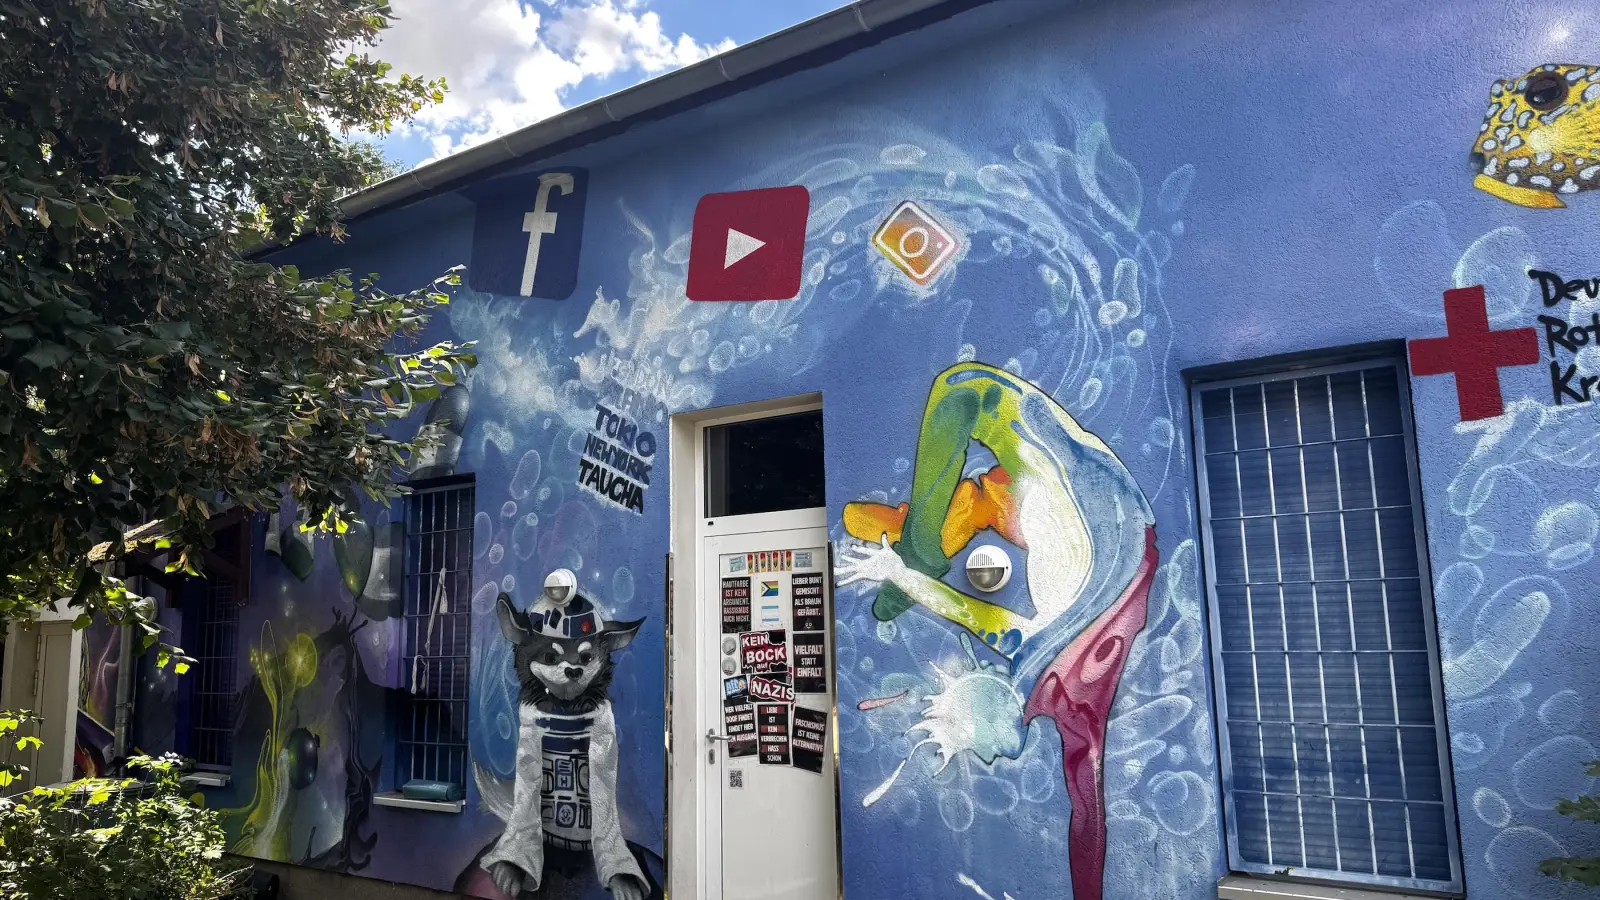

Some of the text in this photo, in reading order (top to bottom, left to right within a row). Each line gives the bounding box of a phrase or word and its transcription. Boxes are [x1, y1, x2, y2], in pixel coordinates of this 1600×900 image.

[1551, 361, 1600, 405] Kr
[595, 403, 657, 457] TOKIO
[579, 458, 644, 514] TAUCHA
[735, 588, 746, 596] KEIN
[742, 635, 768, 647] KEIN
[746, 647, 786, 664] BOCK
[795, 645, 823, 654] VIELFALT
[797, 668, 822, 677] EINFALT
[752, 681, 794, 700] NAZIS
[796, 718, 824, 731] FASCHISMUS
[806, 732, 820, 740] KEINE
[793, 739, 823, 752] ALTERNATIVE
